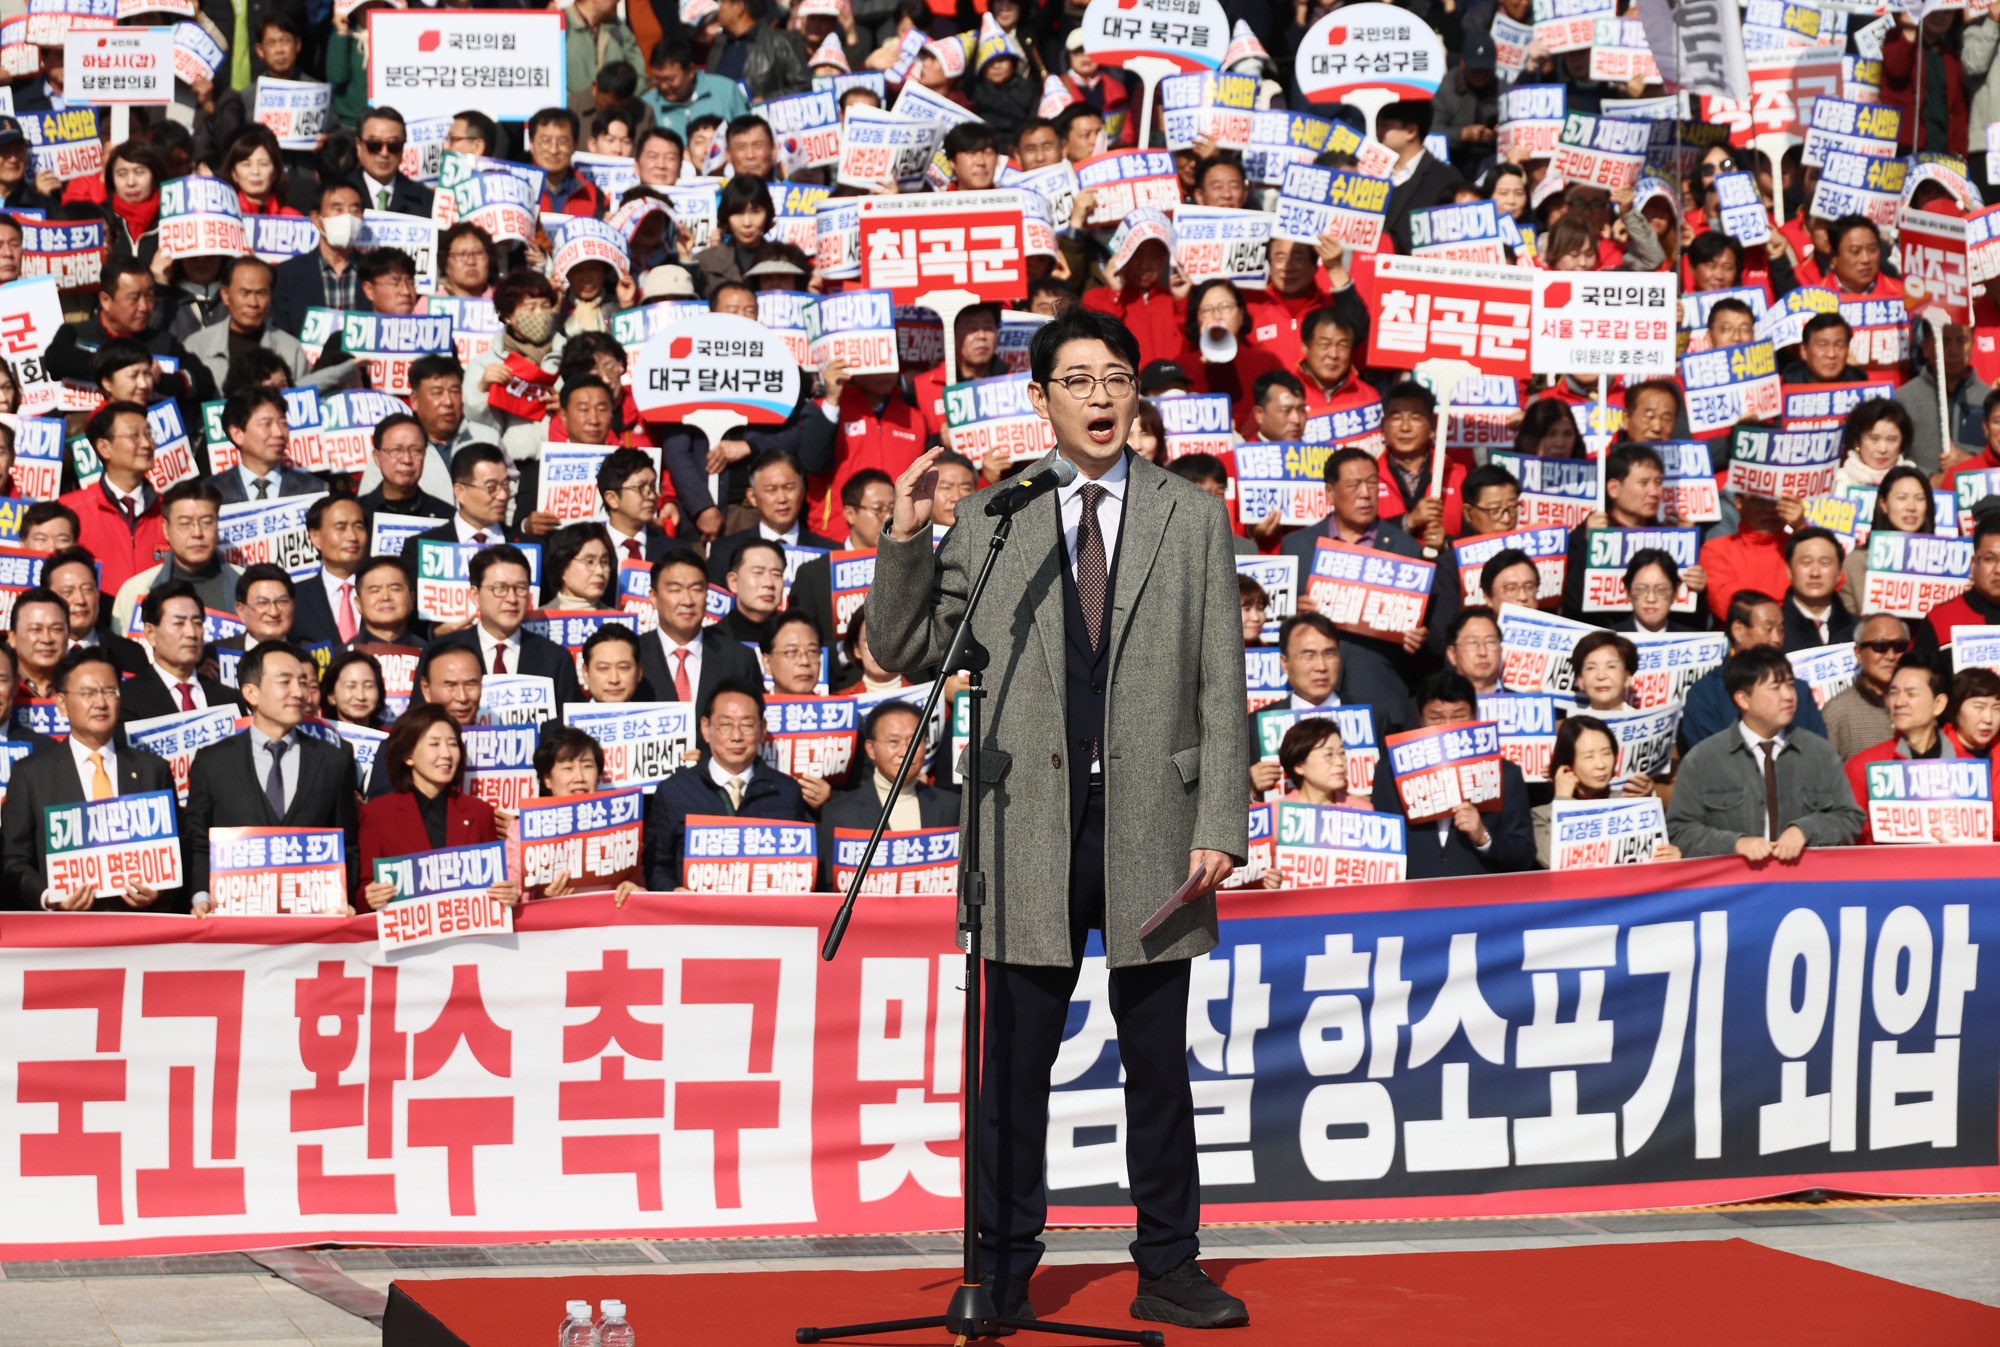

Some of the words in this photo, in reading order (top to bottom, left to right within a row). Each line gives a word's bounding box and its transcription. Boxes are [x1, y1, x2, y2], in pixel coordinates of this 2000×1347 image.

[449, 34, 516, 50] 국민의힘
[1103, 18, 1142, 39] 대구
[1150, 21, 1210, 48] 북구을
[1352, 26, 1411, 42] 국민의힘
[386, 66, 456, 88] 분당구갑
[462, 66, 550, 88] 당원협의회
[1312, 54, 1347, 74] 대구
[1354, 51, 1429, 73] 수성구을
[82, 75, 156, 89] 당원협의회
[161, 178, 185, 219] 5개
[1283, 164, 1331, 202] 대장동
[161, 221, 198, 254] 국민의
[868, 225, 1019, 288] 칠곡군
[1581, 286, 1665, 307] 국민의힘
[345, 317, 376, 350] 5개
[380, 316, 451, 350] 재판재개
[615, 310, 646, 344] 5개
[1377, 289, 1531, 362] 칠곡군
[1540, 320, 1573, 339] 서울
[1580, 320, 1628, 340] 구로갑
[1635, 320, 1667, 340] 당협
[697, 340, 764, 357] 국민의힘
[649, 368, 690, 391] 대구
[698, 369, 784, 393] 달서구병
[1236, 445, 1284, 478] 대장동
[1737, 431, 1769, 464] 5개
[1771, 427, 1841, 467] 재판재개
[1523, 458, 1597, 495] 재판재개
[1731, 465, 1777, 497] 국민의
[422, 543, 454, 580] 5개
[1590, 532, 1623, 567] 5개
[1871, 535, 1905, 571] 5개
[1315, 551, 1364, 577] 대장동
[1363, 558, 1395, 585] 항소
[1395, 564, 1431, 593] 포기
[1869, 578, 1914, 611] 국민의
[1668, 649, 1695, 667] 항소
[520, 687, 547, 704] 포기
[623, 719, 651, 738] 항소
[656, 714, 688, 735] 포기
[784, 707, 818, 732] 항소
[820, 702, 854, 729] 포기
[1621, 725, 1651, 742] 항소
[1393, 738, 1440, 775] 대장동
[1440, 728, 1474, 762] 항소
[1475, 722, 1499, 750] 포기
[1871, 767, 1906, 798] 5개
[1908, 762, 1989, 798] 재판재개
[49, 807, 83, 852] 5개
[88, 794, 173, 848] 재판재개
[524, 806, 574, 838] 대장동
[583, 801, 609, 830] 항소
[610, 791, 640, 821] 포기
[1280, 809, 1316, 844] 5개
[1320, 811, 1401, 851] 재판재개
[1560, 822, 1602, 842] 대장동
[1608, 814, 1634, 834] 항소
[1639, 810, 1662, 834] 포기
[1876, 806, 1922, 838] 국민의
[268, 836, 303, 865] 항소
[305, 833, 340, 862] 포기
[586, 821, 640, 876] 특검하라
[690, 828, 740, 857] 대장동
[741, 828, 777, 857] 항소
[779, 829, 812, 857] 포기
[892, 838, 923, 867] 항소
[418, 845, 505, 892] 재판재개
[382, 902, 433, 943] 국민의
[437, 894, 507, 934] 명령이다
[17, 968, 246, 1225] 국고
[290, 960, 514, 1216] 환수
[558, 950, 782, 1212] 촉구
[857, 953, 966, 1203] 및
[1299, 910, 1728, 1181] 항소포기
[1759, 903, 1979, 1156] 외압
